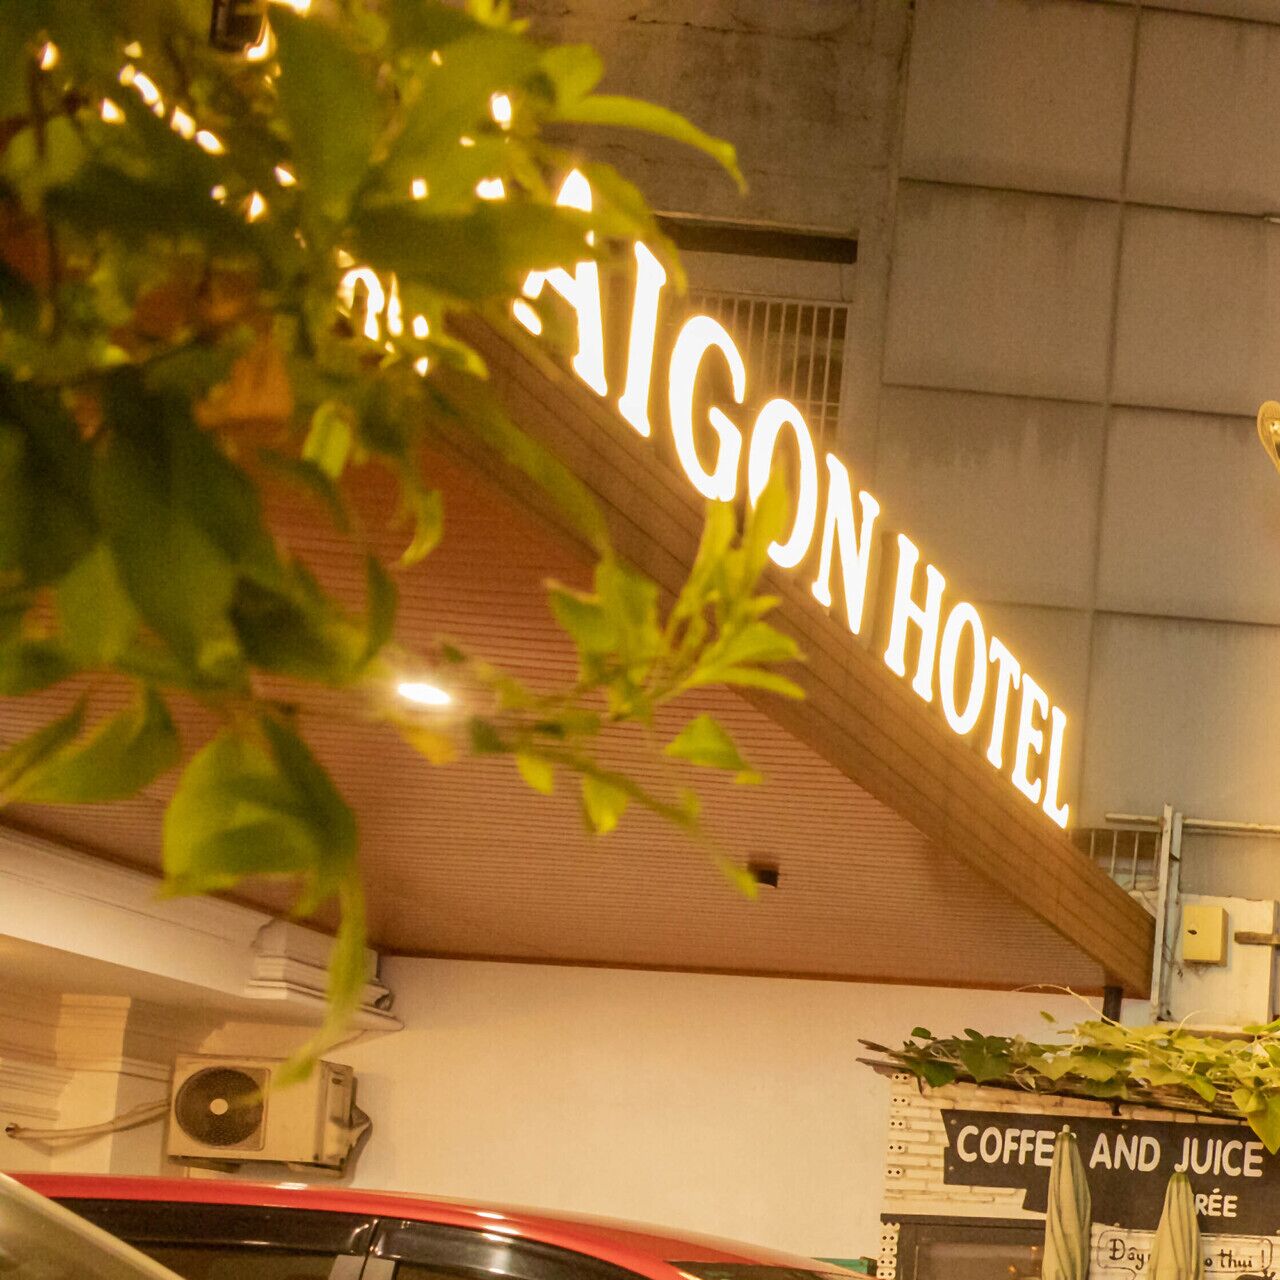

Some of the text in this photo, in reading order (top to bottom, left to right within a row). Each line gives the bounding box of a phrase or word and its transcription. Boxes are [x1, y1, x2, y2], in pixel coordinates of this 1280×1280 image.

[410, 92, 881, 635] AIGON
[884, 532, 1071, 830] HOTEL
[957, 1125, 1264, 1178] COFFE AND JUICE
